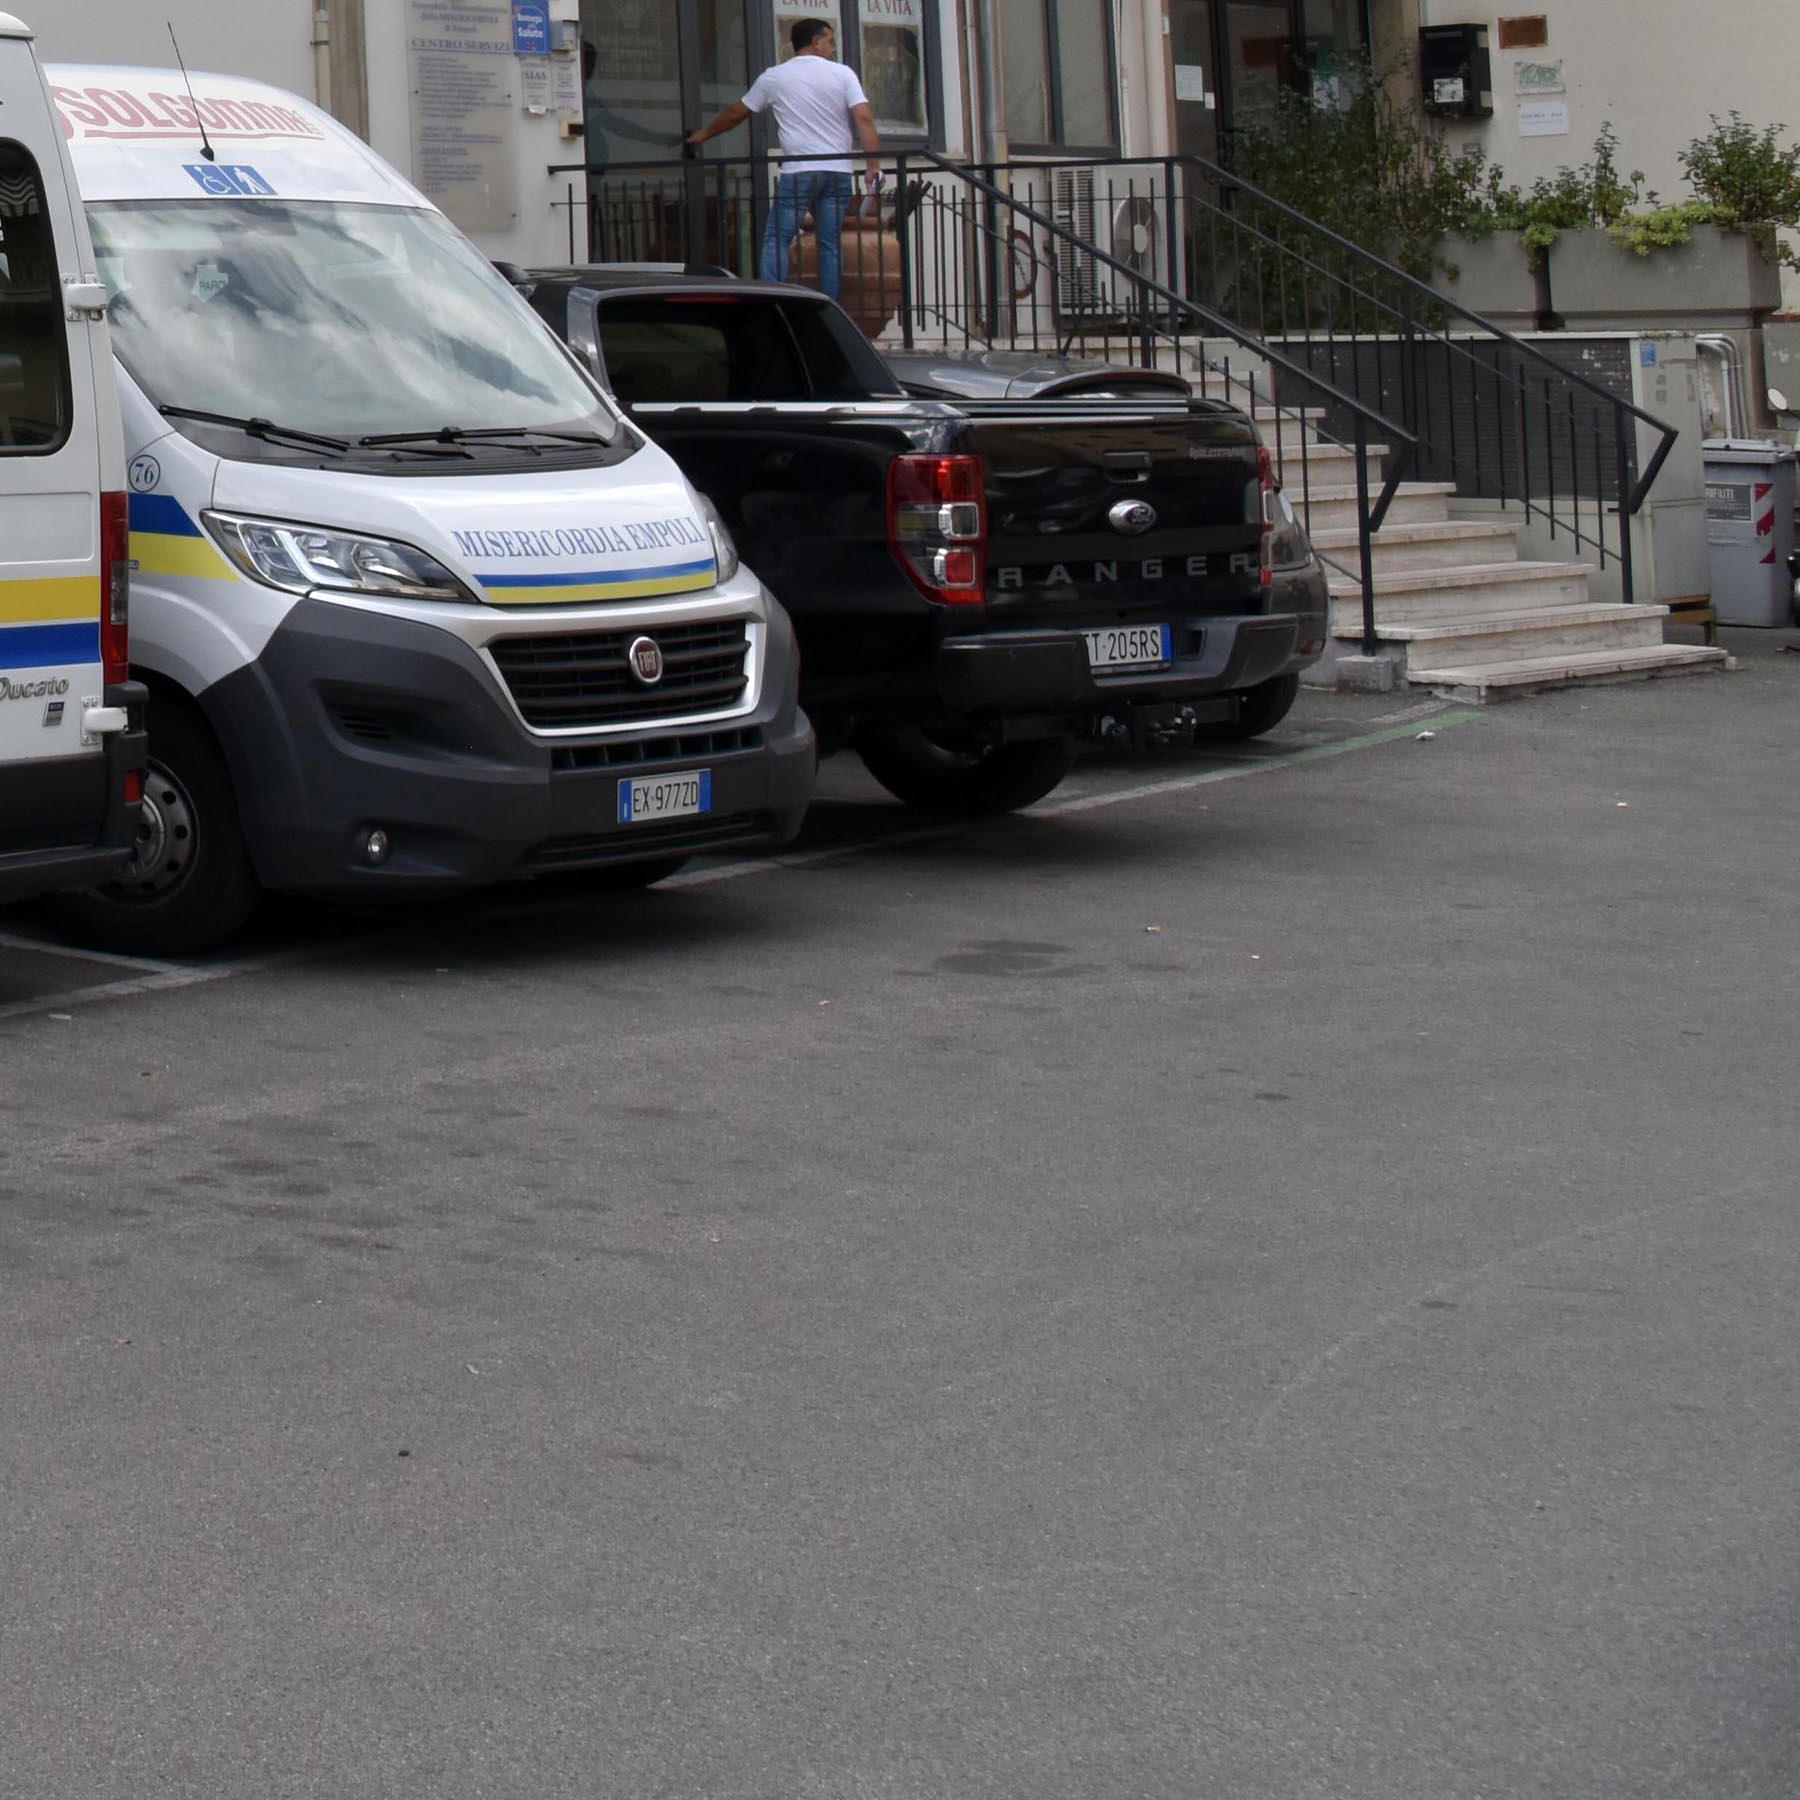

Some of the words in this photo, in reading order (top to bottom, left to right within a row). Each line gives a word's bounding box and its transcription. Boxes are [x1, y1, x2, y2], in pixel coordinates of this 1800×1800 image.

[411, 37, 462, 49] CENTRO
[463, 39, 510, 51] SERVIZI
[134, 462, 155, 485] 76
[451, 525, 632, 559] MISERICORDIA
[622, 516, 708, 551] EMPOLI
[997, 553, 1260, 588] RANGER
[1107, 629, 1160, 661] 205RS
[632, 786, 651, 814] EX
[654, 780, 700, 811] 977ZD
